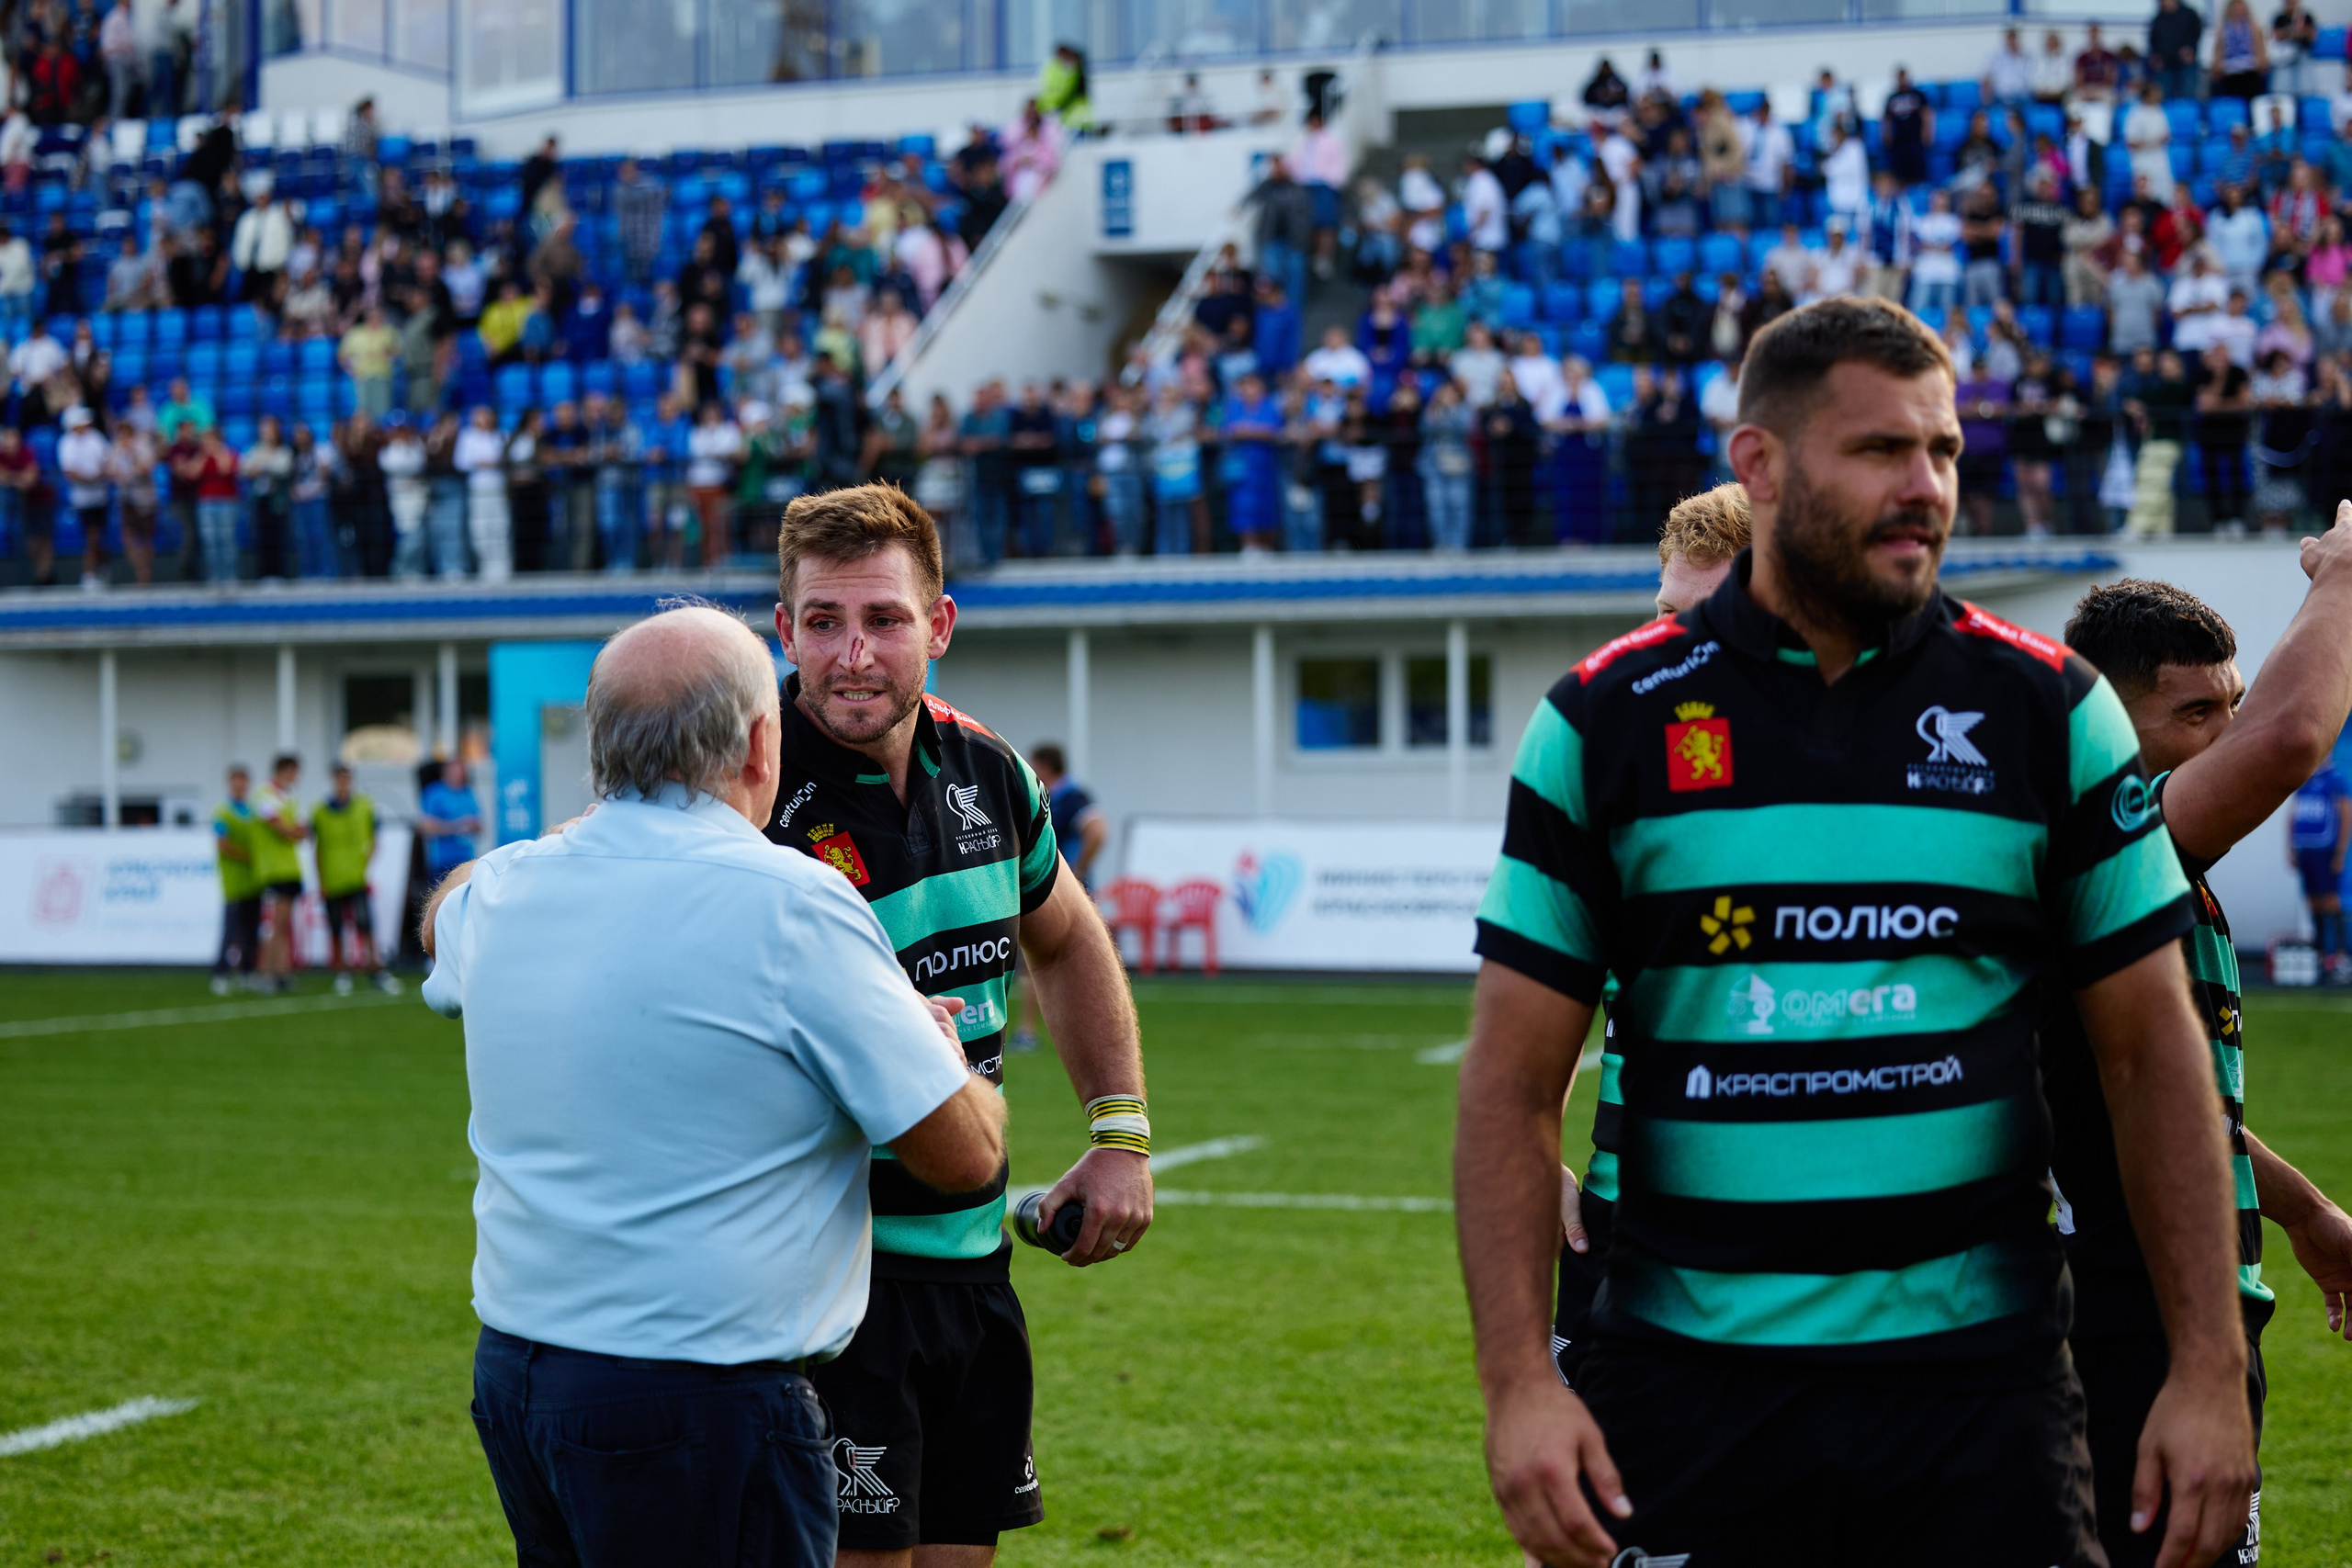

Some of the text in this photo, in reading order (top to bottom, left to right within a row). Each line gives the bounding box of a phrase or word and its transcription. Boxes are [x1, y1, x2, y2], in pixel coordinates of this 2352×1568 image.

[1774, 905, 1960, 942] ПОЛЮС
[915, 936, 1011, 982] ПОЛЮС
[1715, 1055, 1963, 1097] КРАСПРОМСТРОЙ
